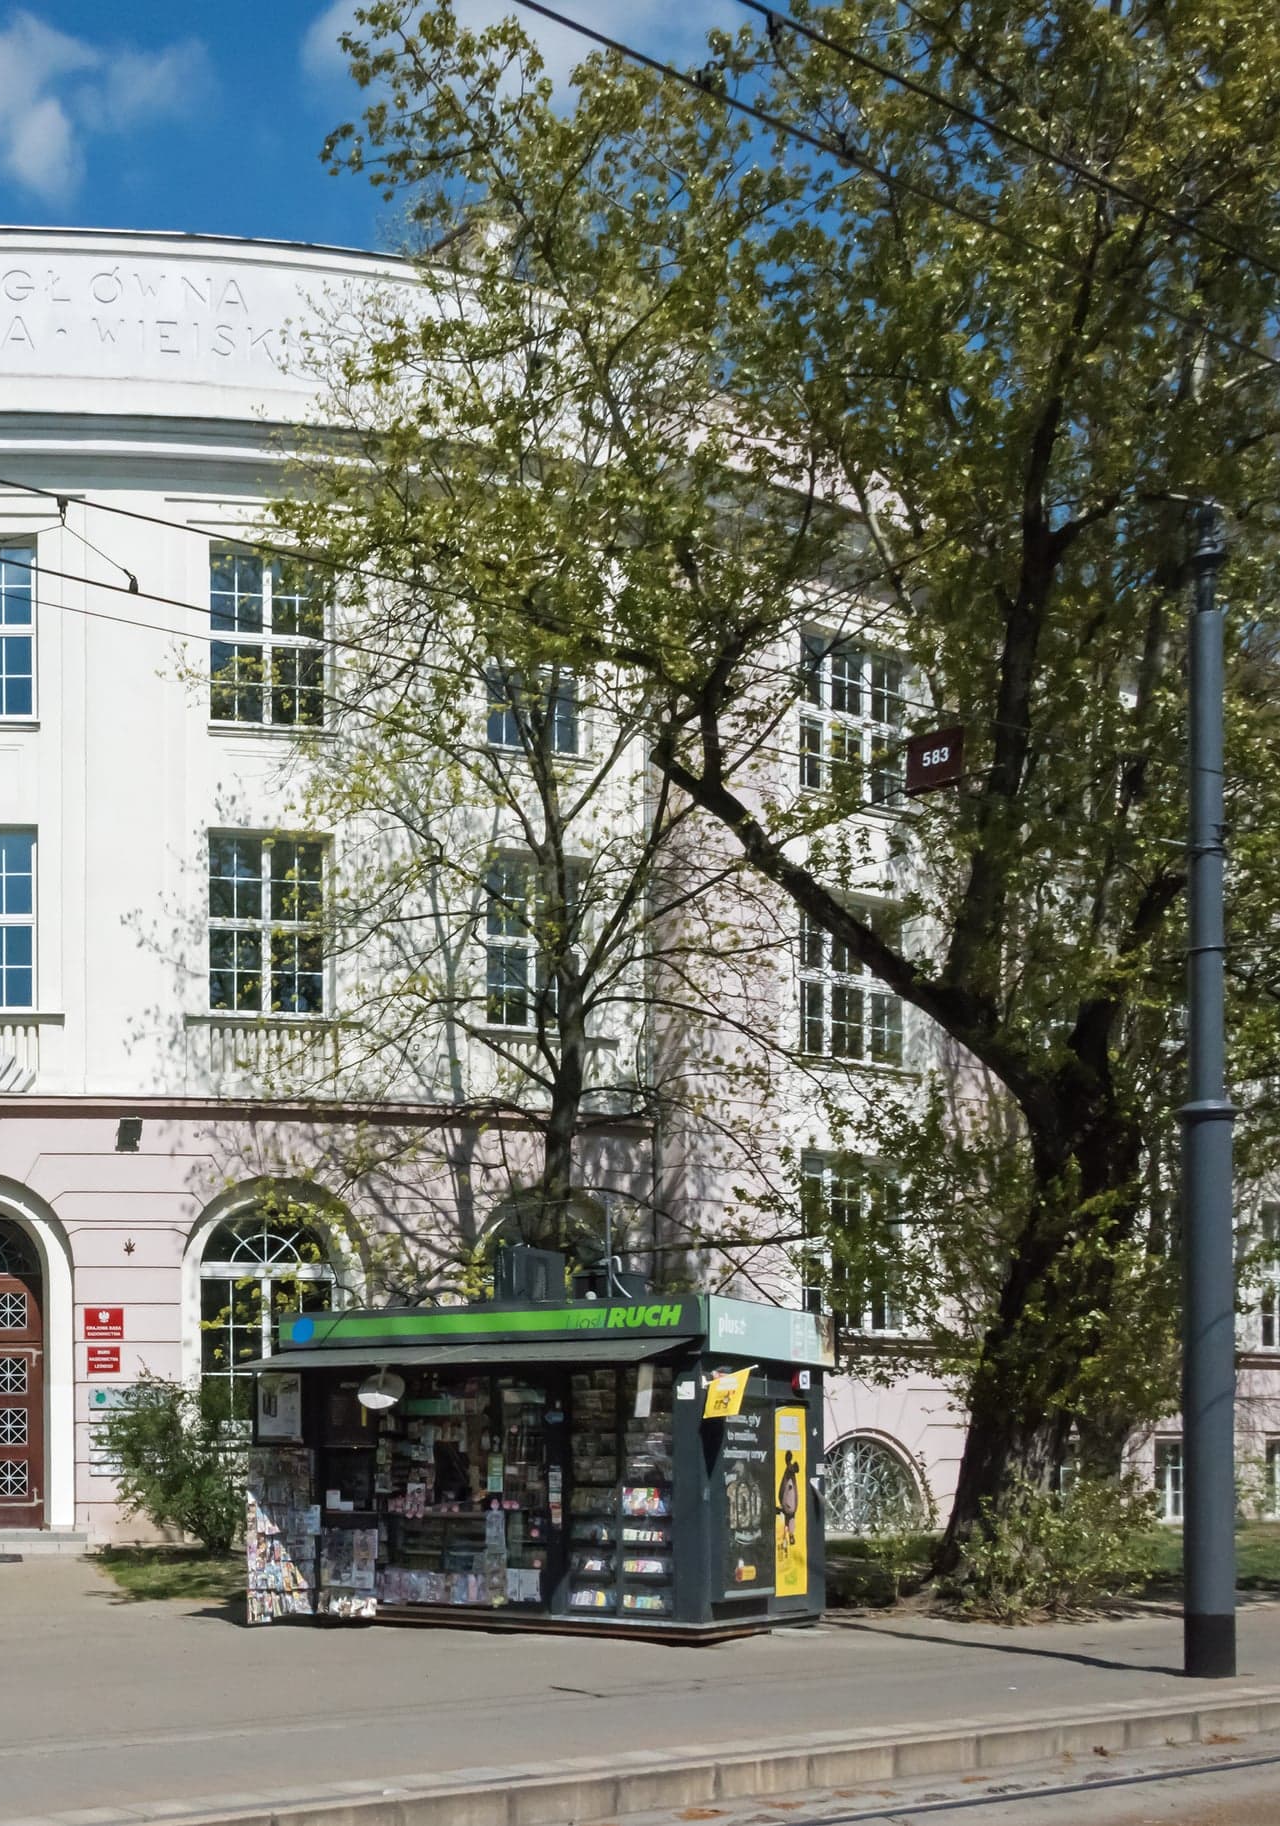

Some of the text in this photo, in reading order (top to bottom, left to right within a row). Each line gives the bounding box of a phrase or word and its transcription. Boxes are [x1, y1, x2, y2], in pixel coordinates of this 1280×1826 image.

[1, 266, 249, 314] GŁÓWNA
[922, 746, 950, 767] 583
[607, 1304, 682, 1328] RUCH
